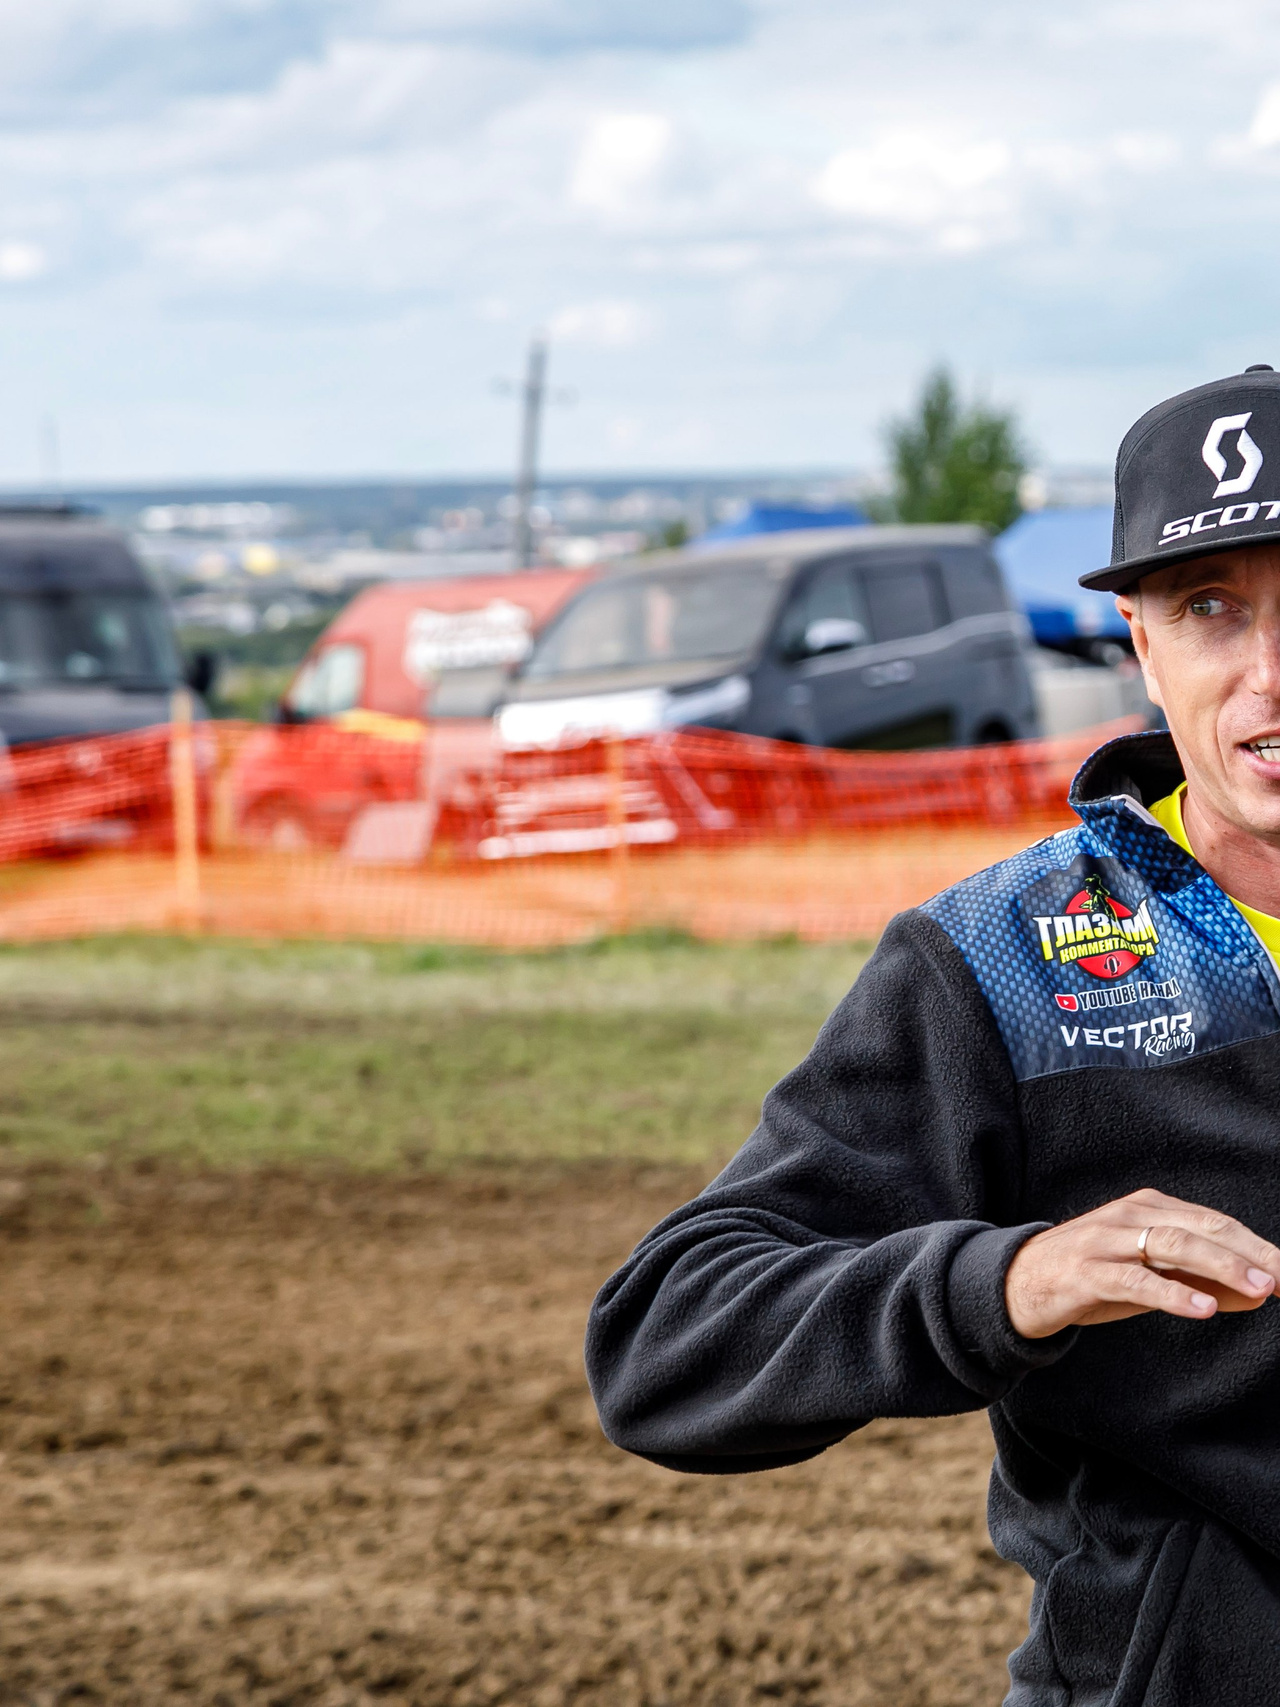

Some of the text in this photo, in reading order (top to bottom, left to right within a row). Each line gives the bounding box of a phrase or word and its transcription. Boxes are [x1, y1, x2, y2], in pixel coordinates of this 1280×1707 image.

[1078, 984, 1137, 1010] YOUTUBE
[1060, 1011, 1192, 1050] VECTOR
[1142, 1030, 1196, 1057] Racing
